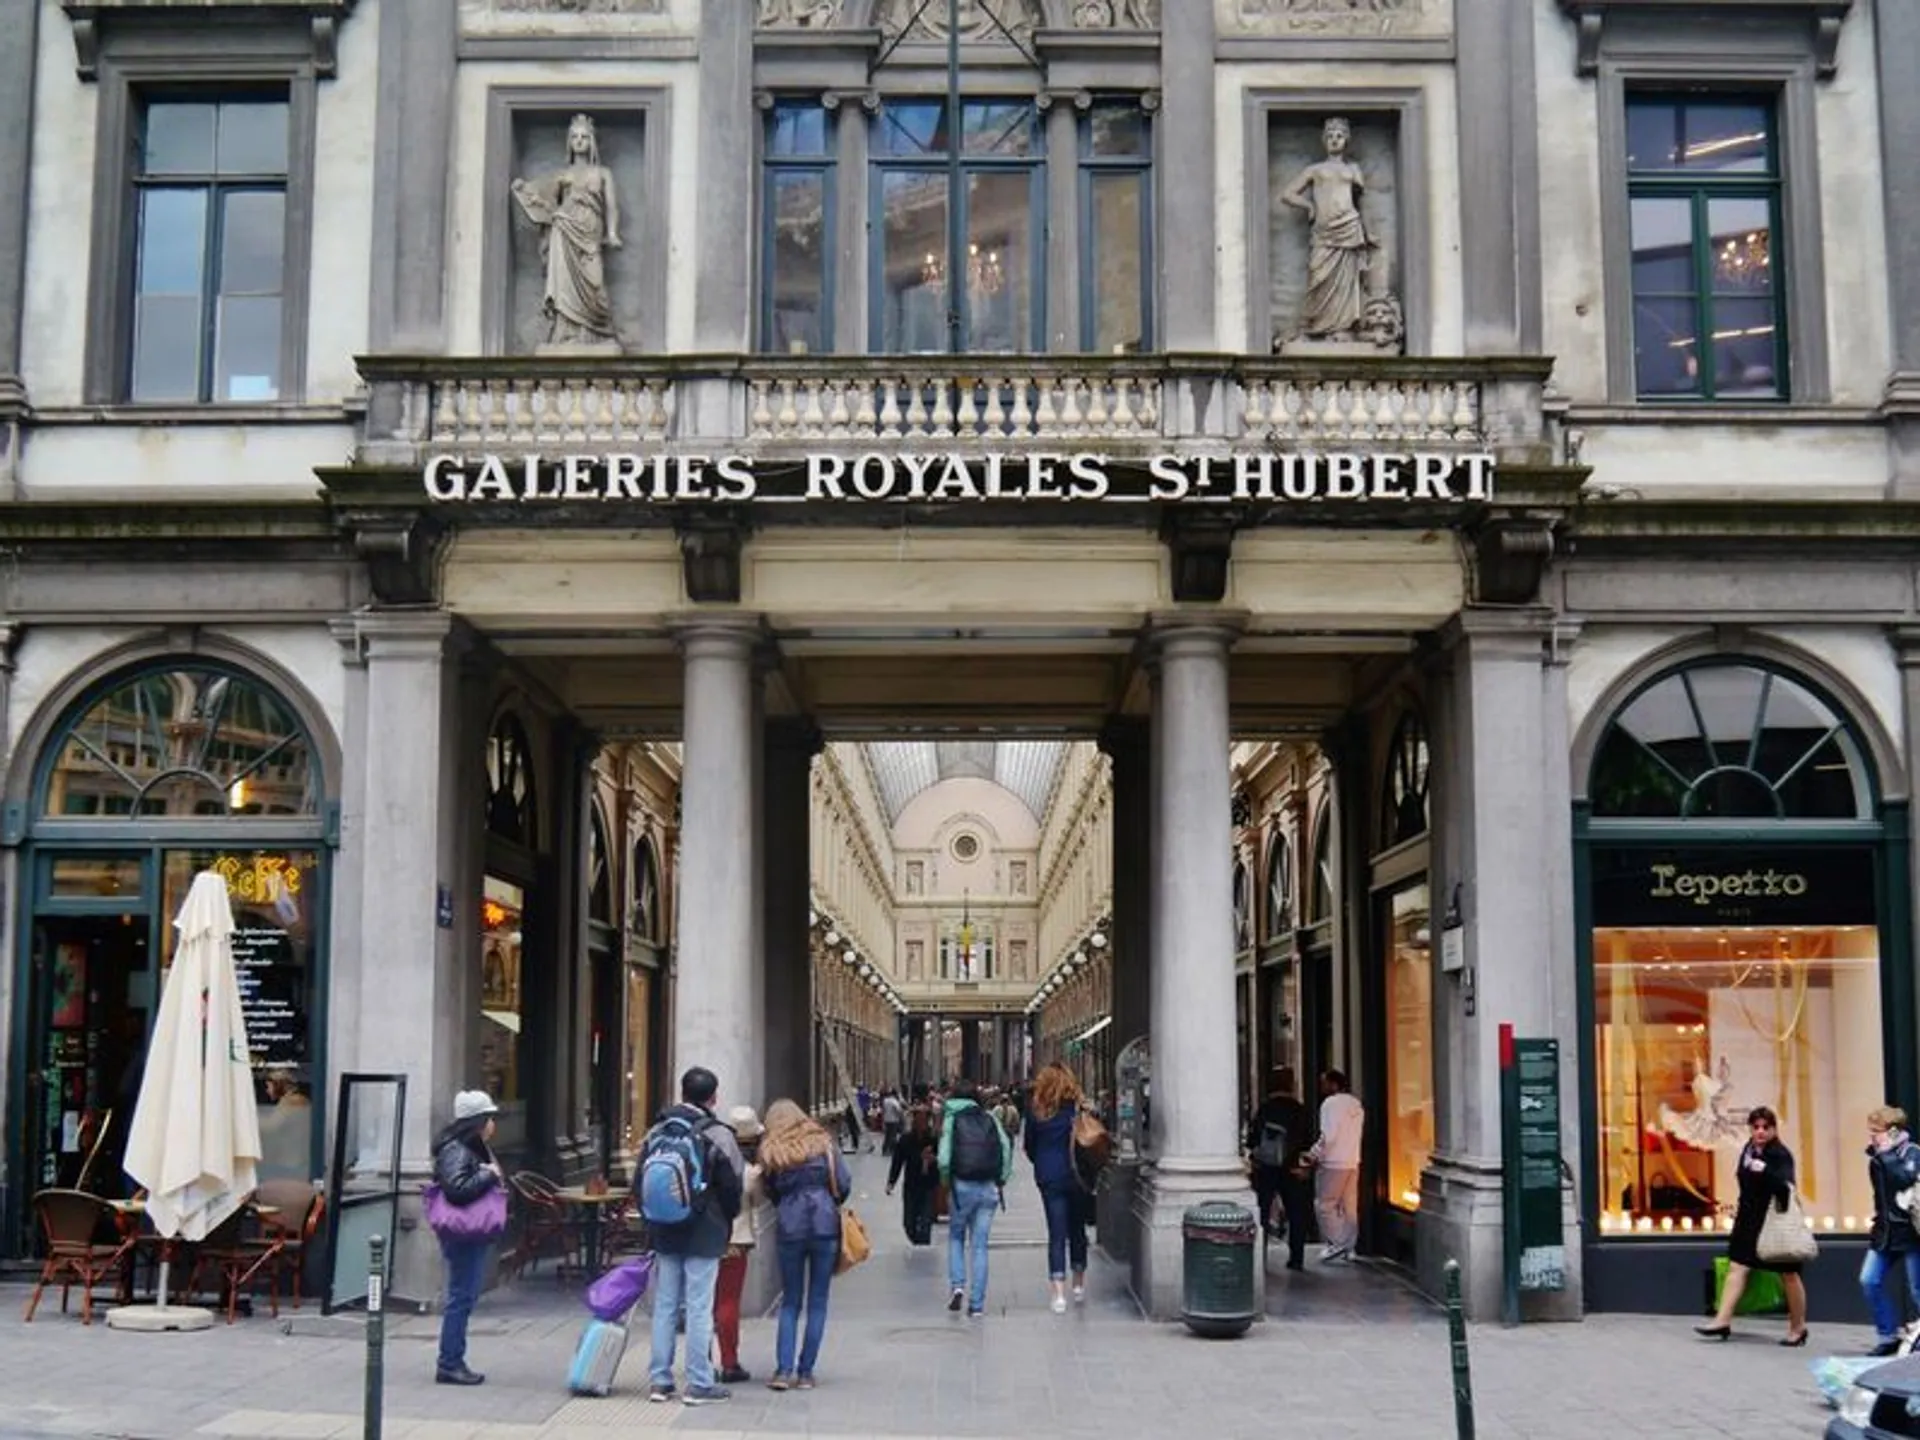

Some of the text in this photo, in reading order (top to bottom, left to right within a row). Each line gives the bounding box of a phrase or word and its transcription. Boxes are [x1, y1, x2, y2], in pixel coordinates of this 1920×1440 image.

[423, 454, 757, 501] GALERIES
[804, 452, 1110, 500] ROYALES
[1232, 453, 1495, 500] HUBERT
[1651, 864, 1808, 904] repetto
